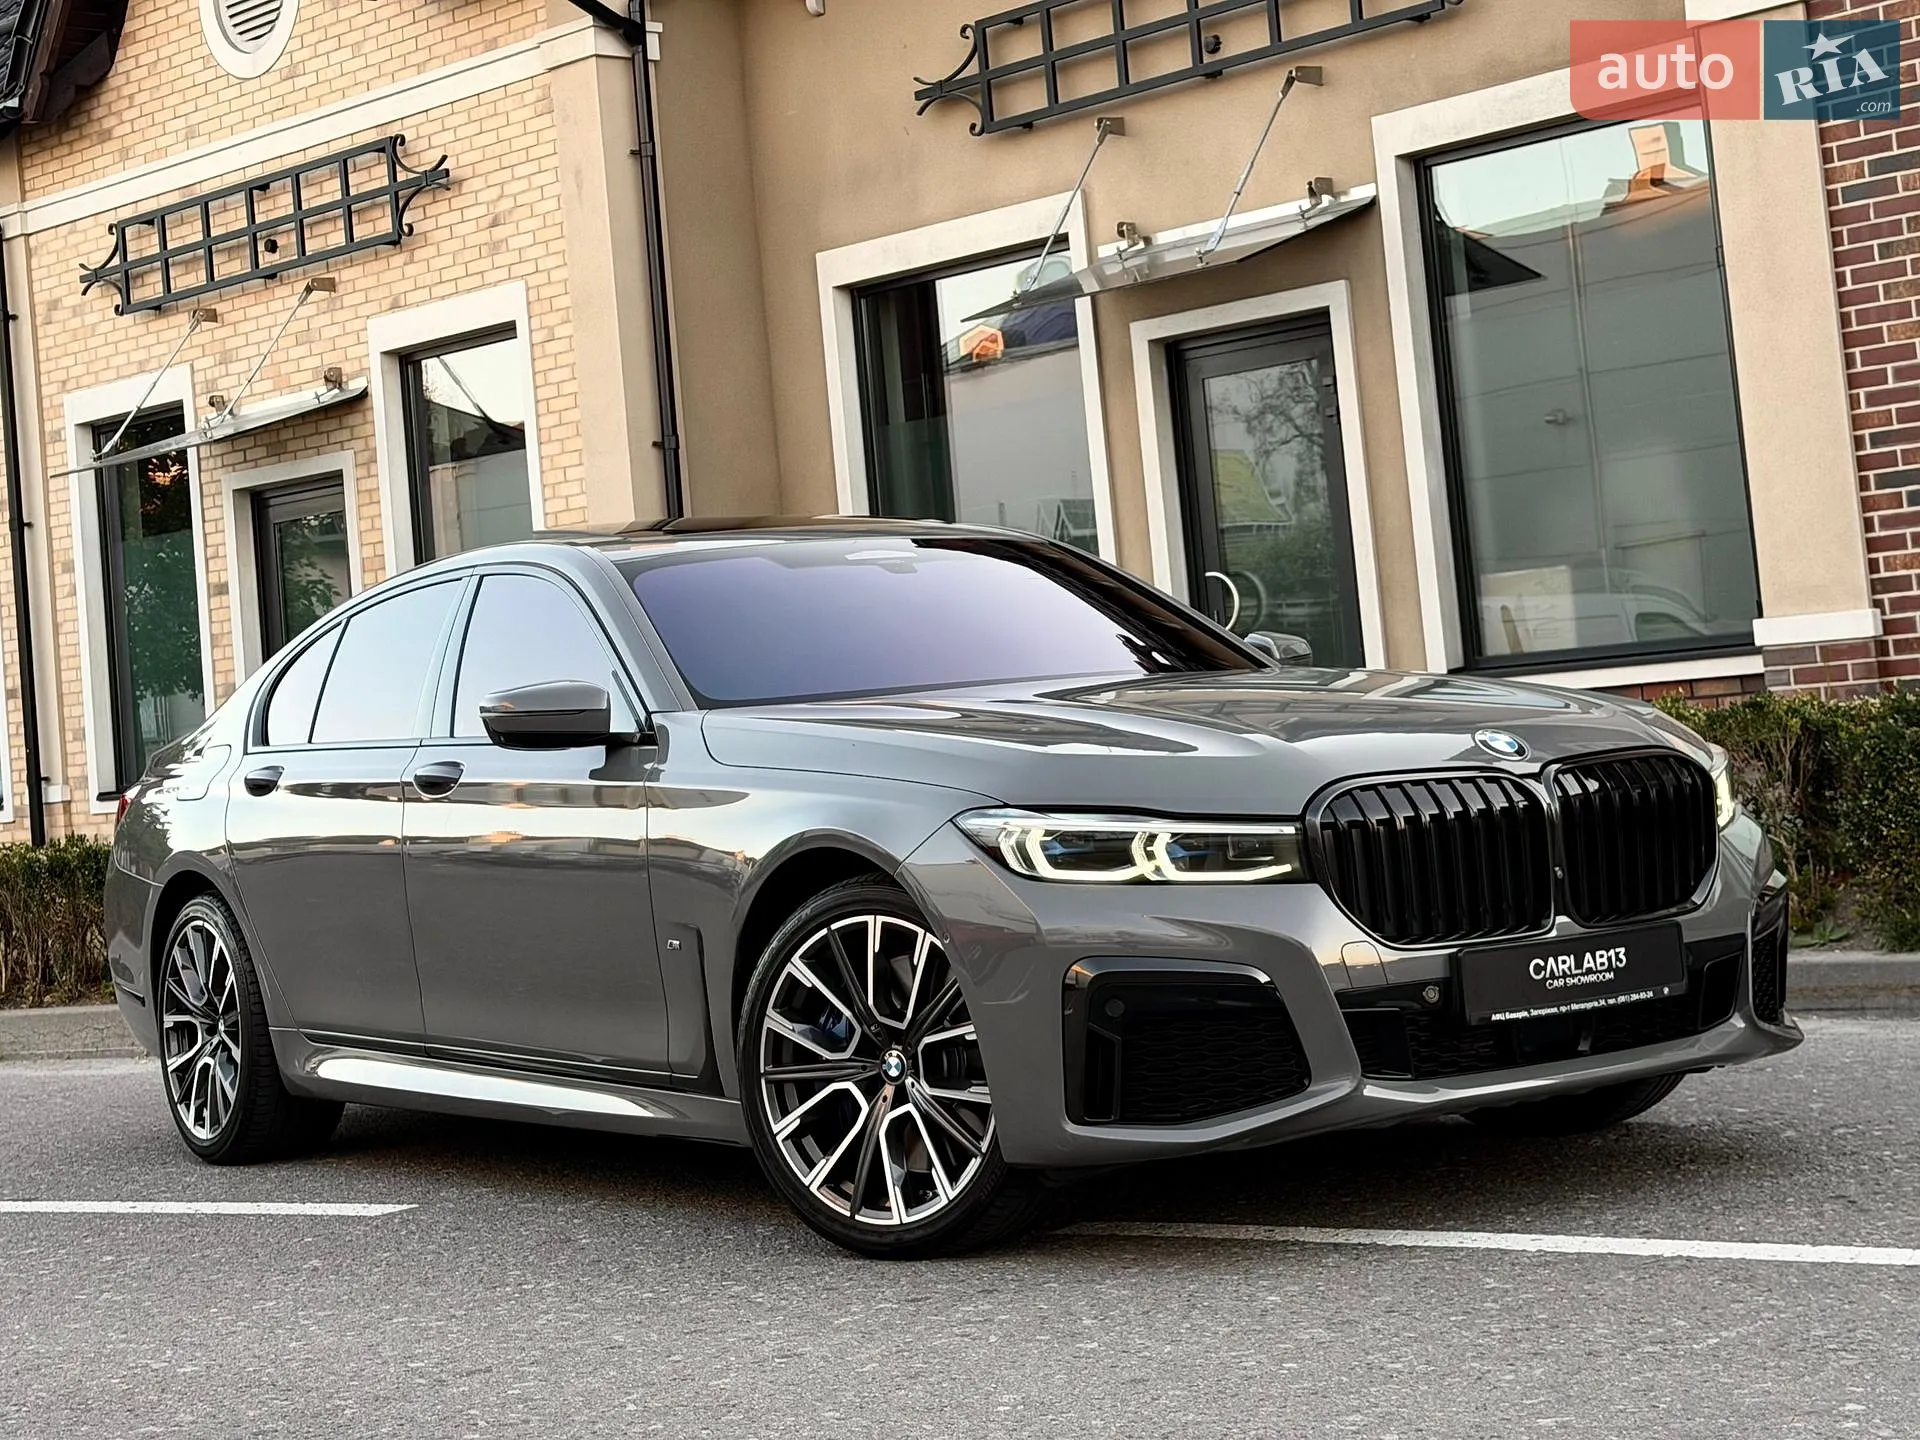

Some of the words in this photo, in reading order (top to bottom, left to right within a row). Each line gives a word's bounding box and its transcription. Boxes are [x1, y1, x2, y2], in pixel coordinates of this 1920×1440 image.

[1529, 946, 1627, 980] CARLAB13
[1546, 977, 1565, 989] CAR
[1565, 971, 1614, 987] SHOWROOM
